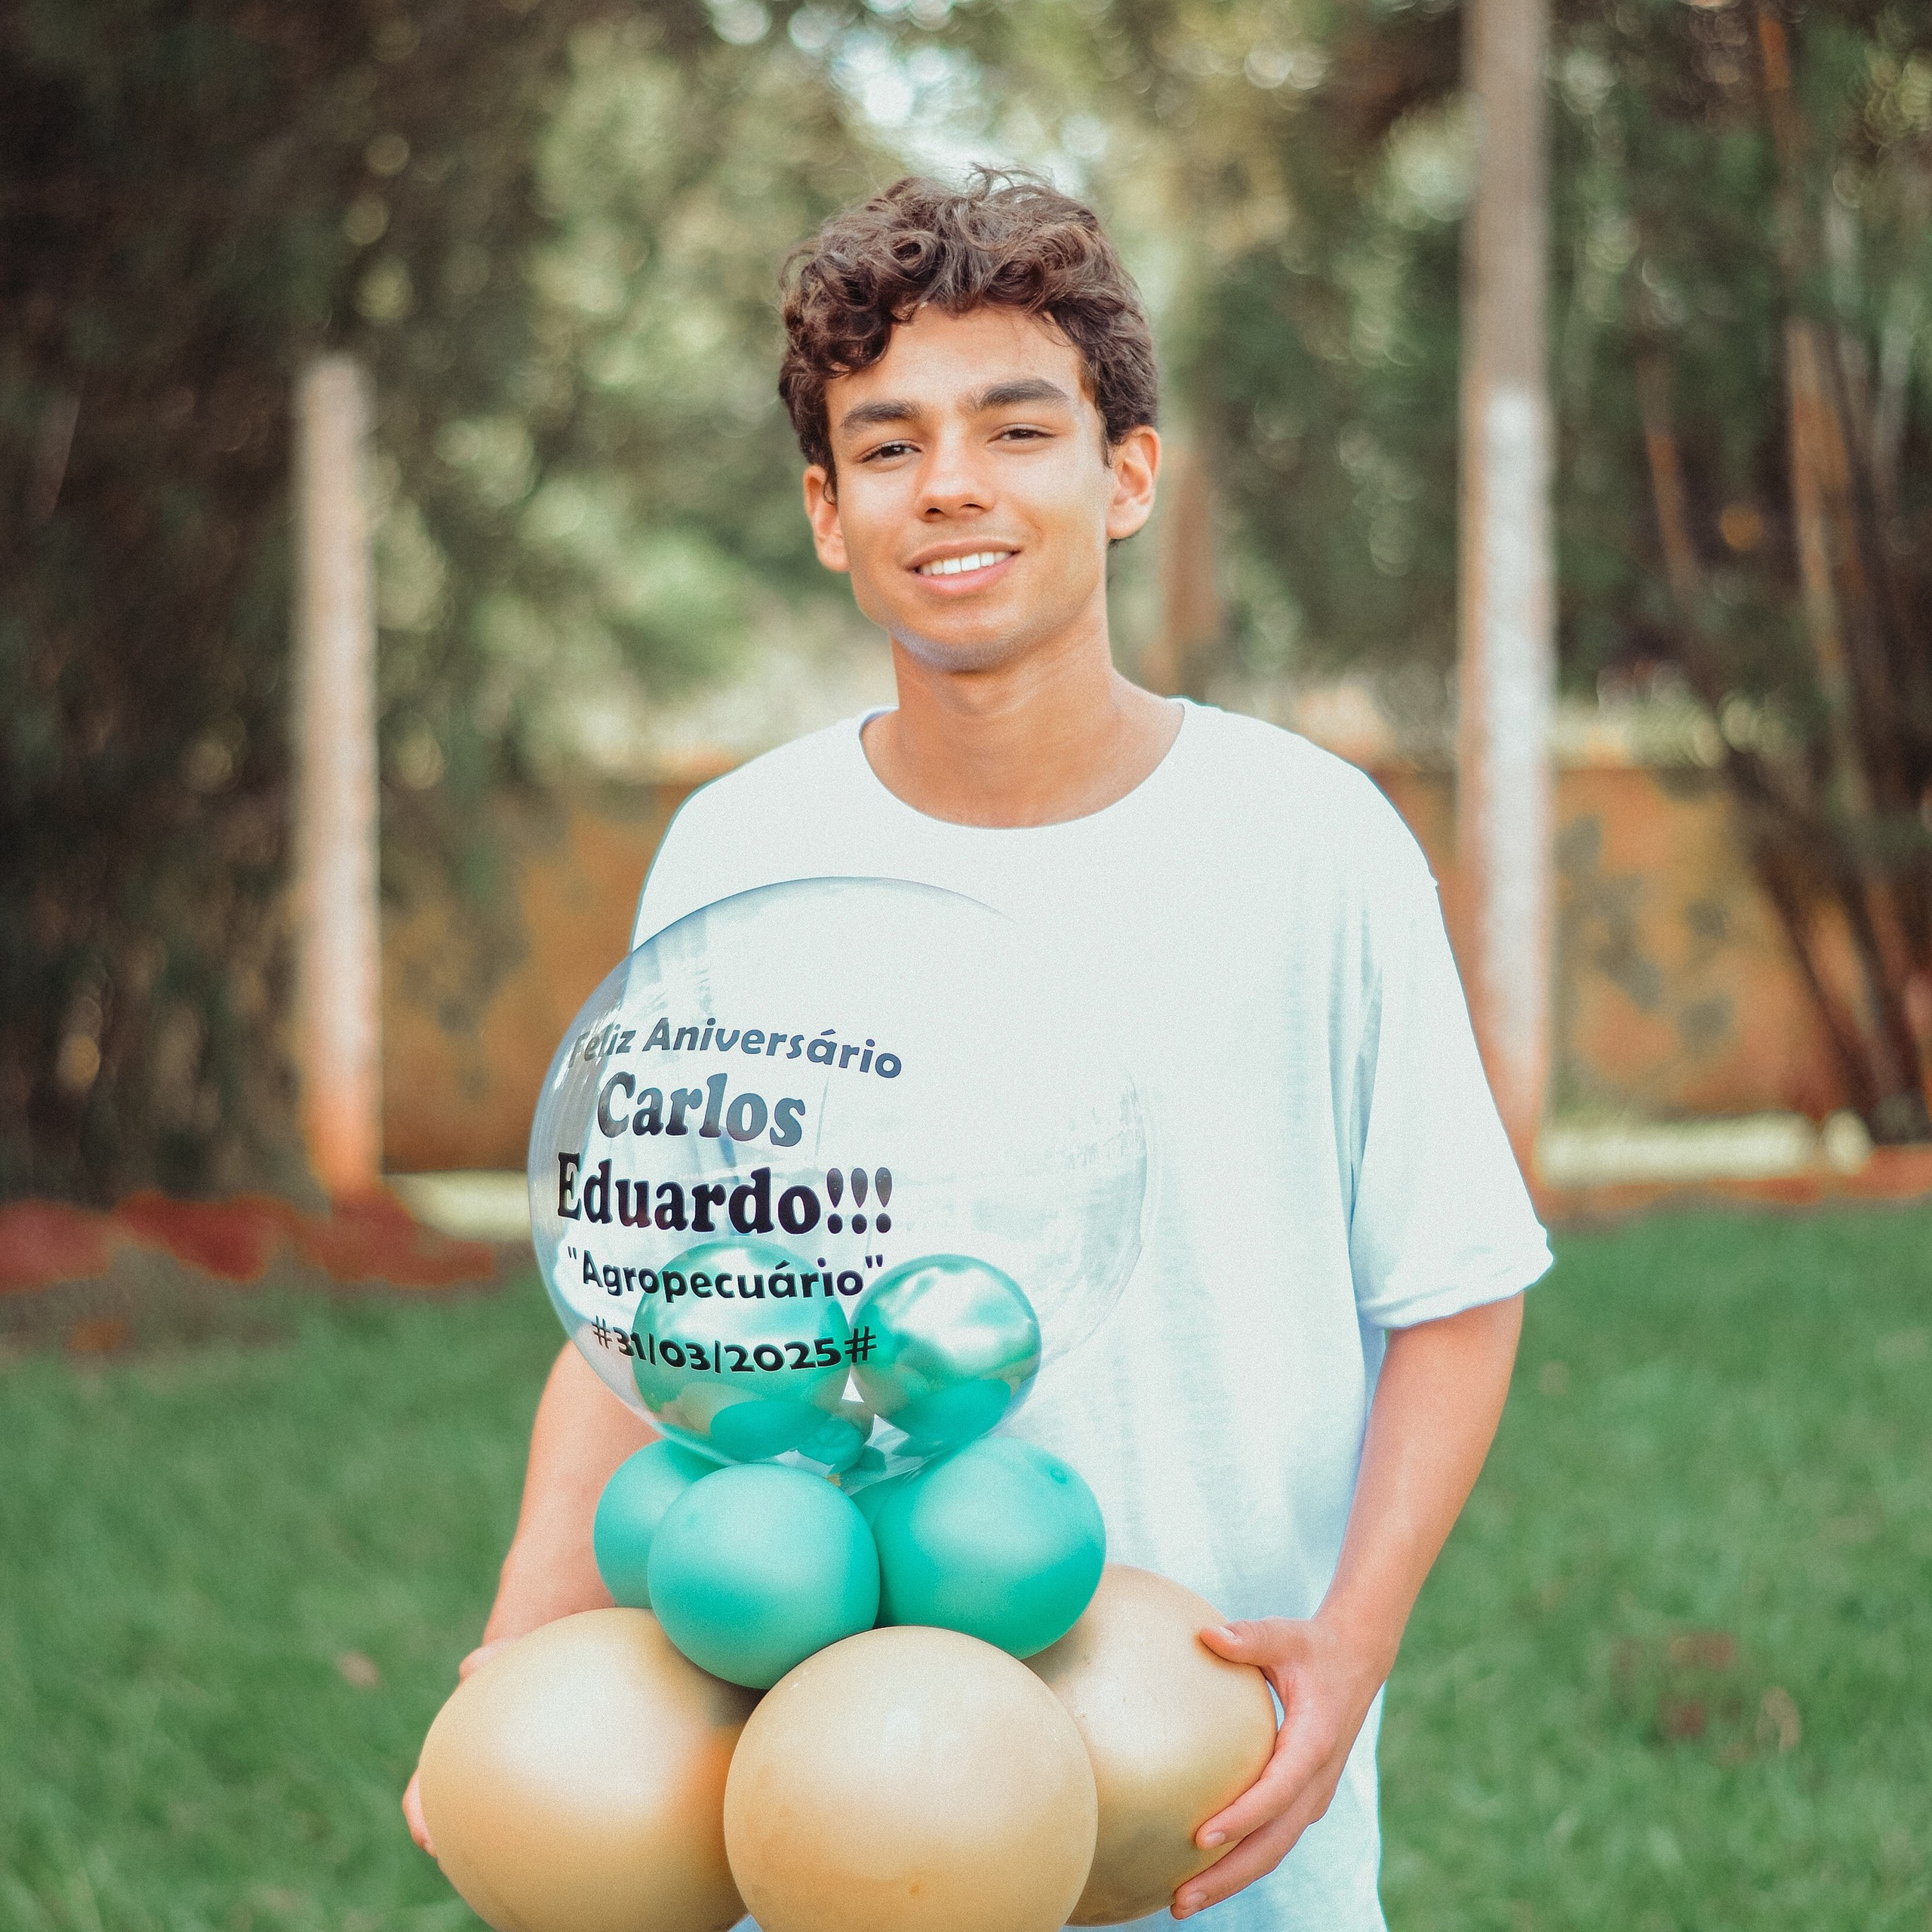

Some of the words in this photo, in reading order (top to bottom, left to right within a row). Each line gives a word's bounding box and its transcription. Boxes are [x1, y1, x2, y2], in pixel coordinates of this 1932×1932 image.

[568, 1022, 636, 1068] Feliz
[642, 1017, 902, 1078] Aniversário
[598, 1071, 806, 1146] Carlos
[557, 1152, 893, 1235] Eduardo!!!
[567, 1245, 884, 1303] "Agropecuário"
